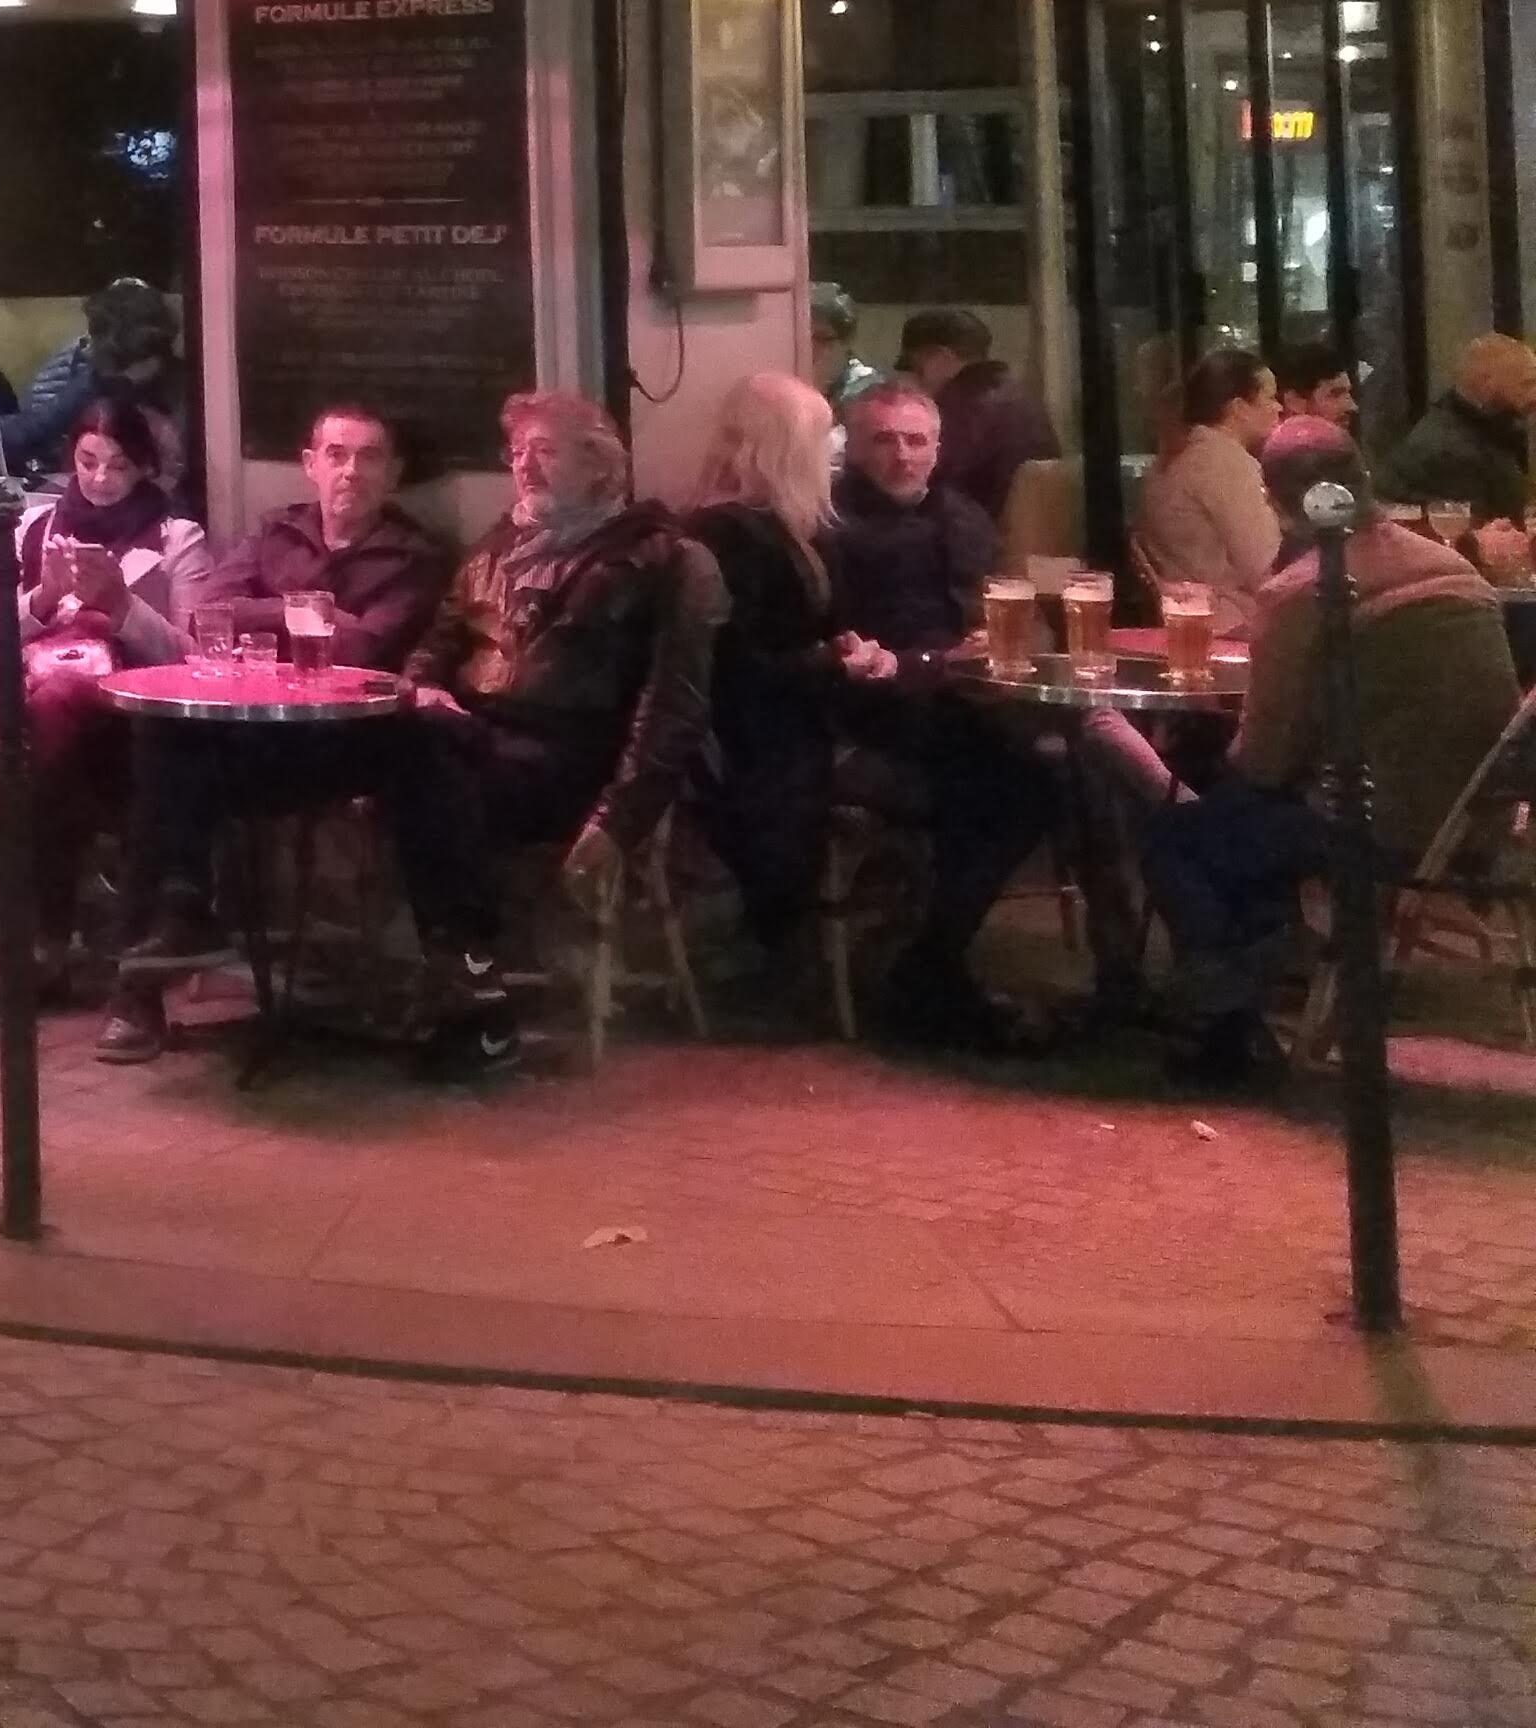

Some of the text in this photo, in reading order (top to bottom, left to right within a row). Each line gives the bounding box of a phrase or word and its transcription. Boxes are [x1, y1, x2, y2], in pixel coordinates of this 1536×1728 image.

[255, 1, 370, 25] FORMULE
[254, 225, 369, 245] FORMULE
[377, 225, 446, 244] PETIT
